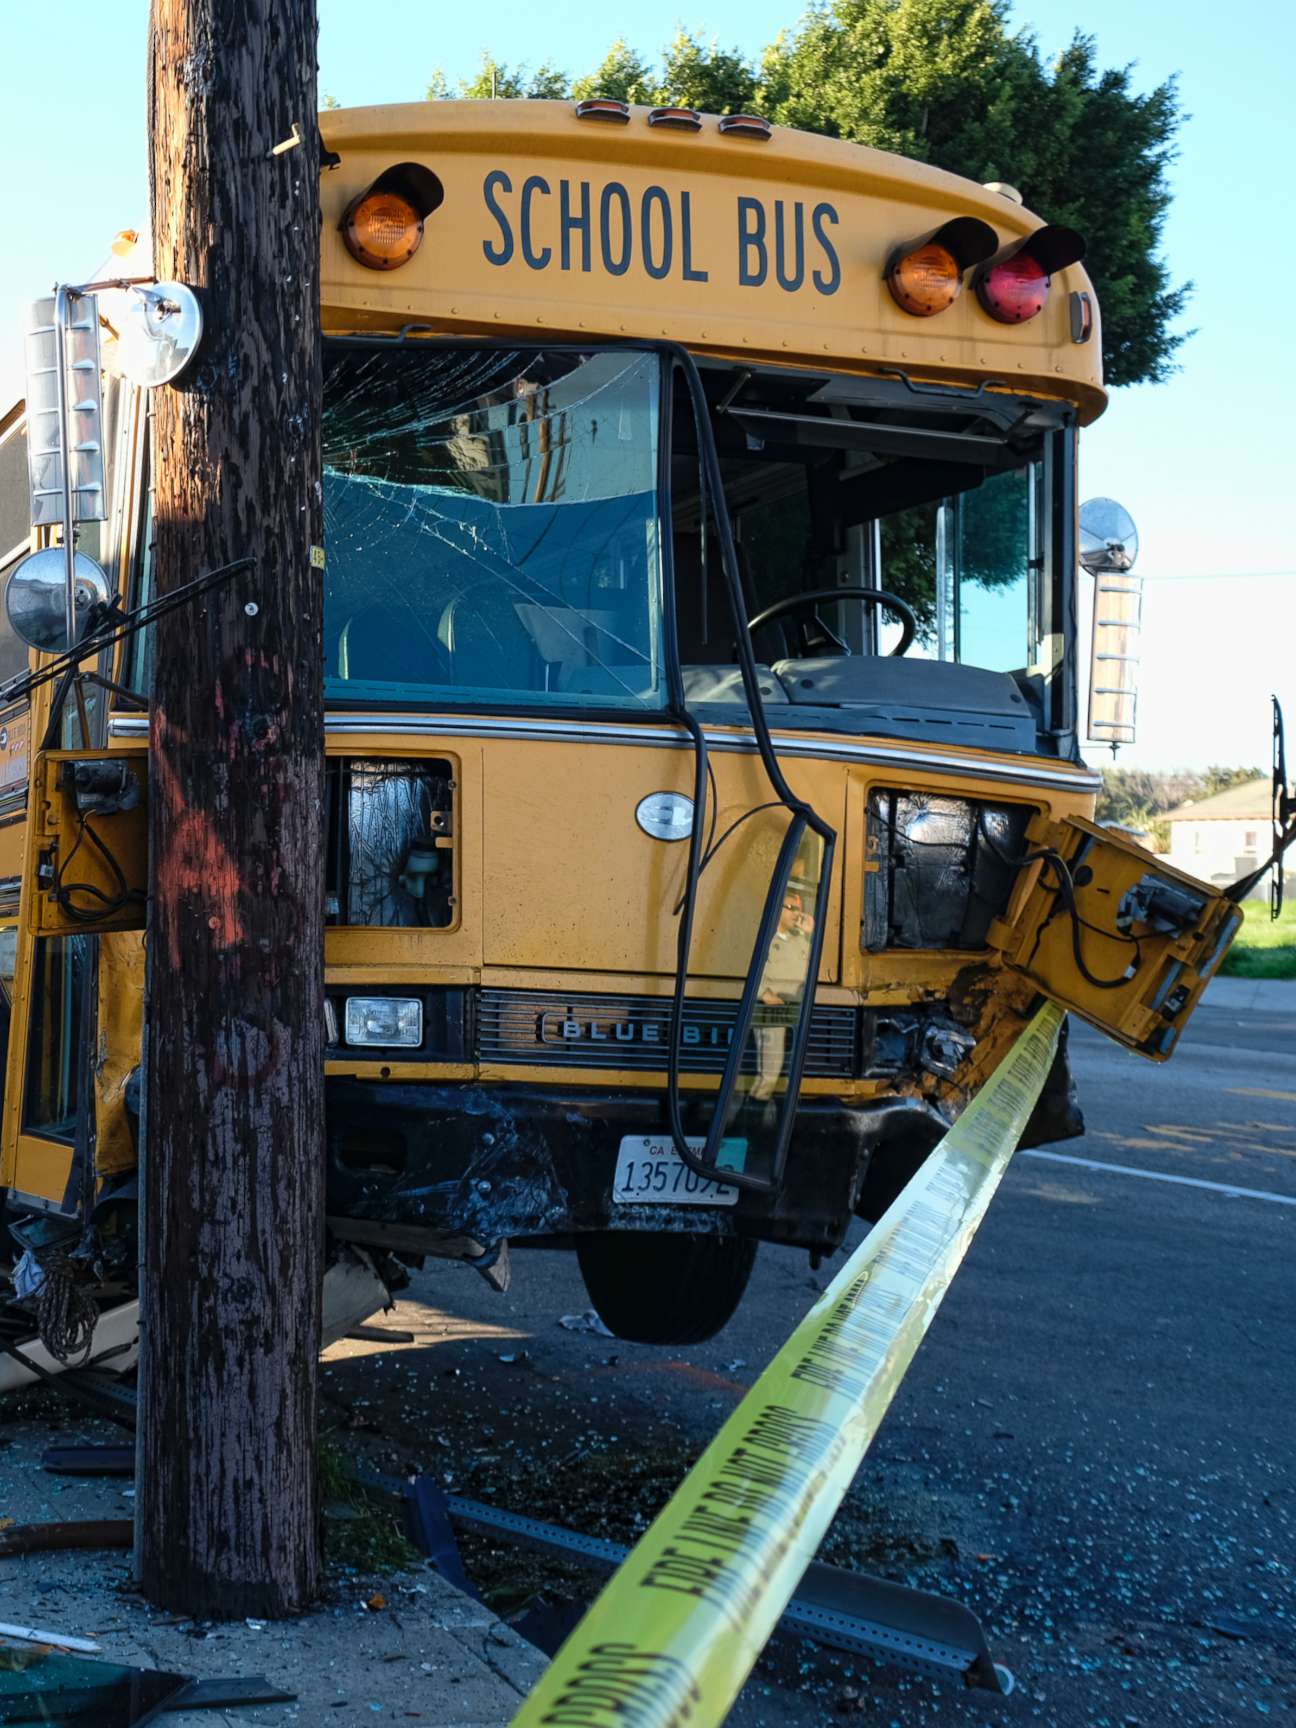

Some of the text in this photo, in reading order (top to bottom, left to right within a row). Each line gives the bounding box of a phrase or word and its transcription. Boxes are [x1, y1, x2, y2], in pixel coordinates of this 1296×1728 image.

[482, 169, 842, 297] SCHOOL BUS
[562, 1020, 735, 1045] BLUE BI
[649, 1145, 665, 1156] CA
[621, 1161, 730, 1195] 135702
